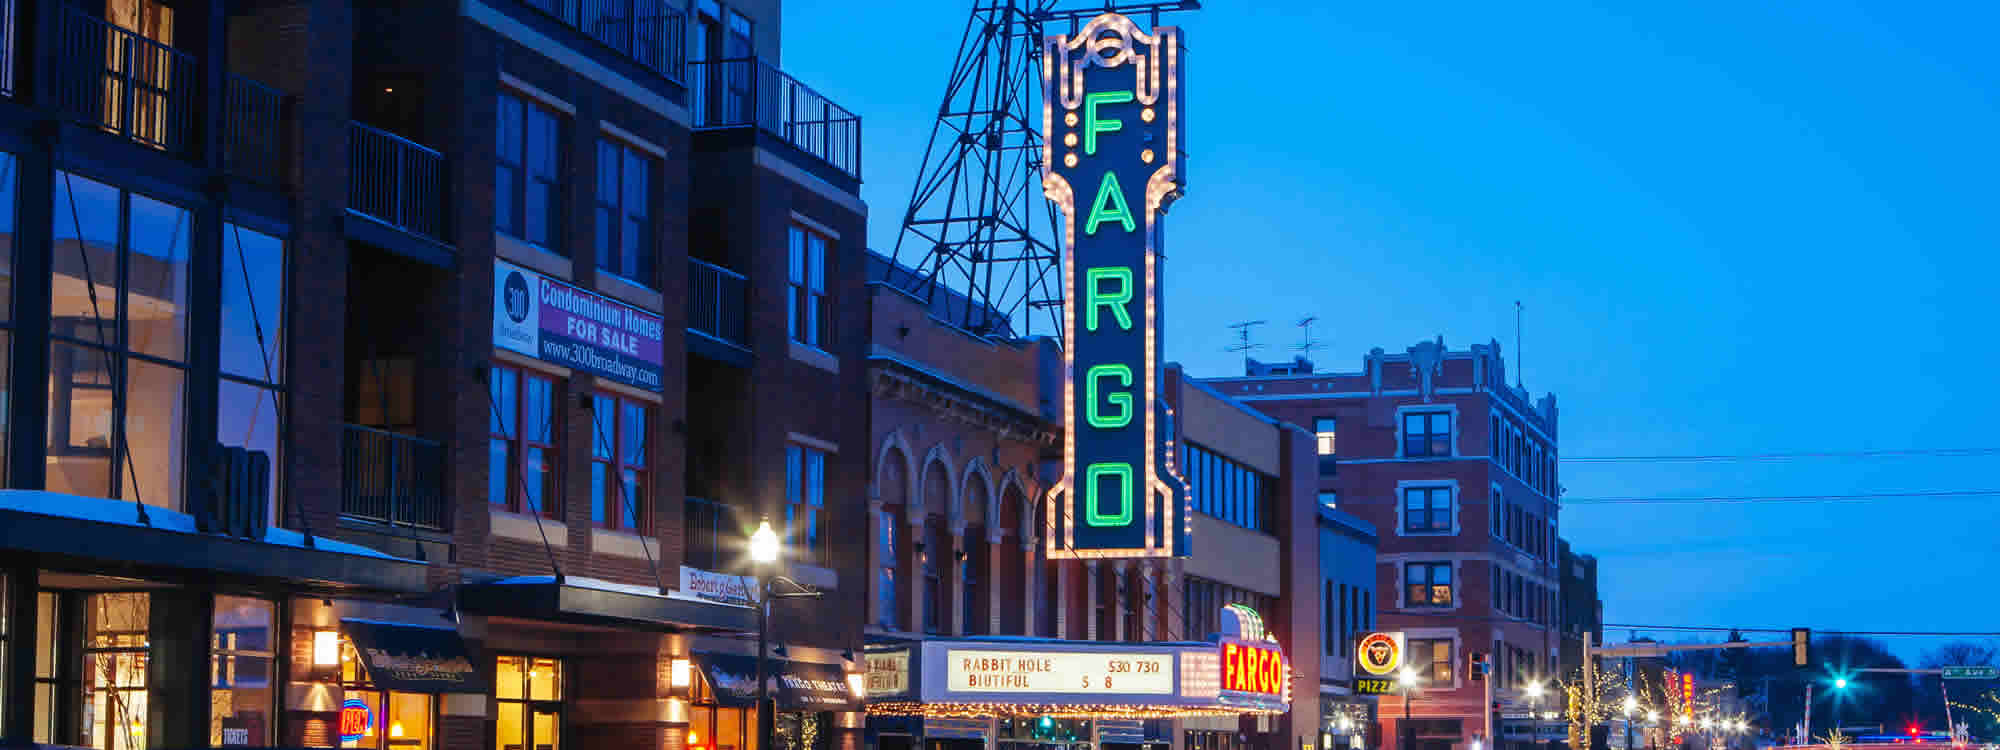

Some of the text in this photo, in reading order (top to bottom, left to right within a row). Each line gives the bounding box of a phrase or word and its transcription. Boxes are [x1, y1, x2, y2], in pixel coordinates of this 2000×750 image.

[541, 279, 663, 341] Condominium Homes
[1084, 90, 1136, 528] FARGO
[567, 316, 597, 342] FOR
[601, 328, 639, 355] SALE
[543, 340, 658, 385] www.300broadway.com
[963, 658, 1011, 673] RABBIT
[1018, 659, 1052, 673] HOLE
[1137, 661, 1160, 673] 730
[968, 674, 1030, 688] BIUTIFUL
[1104, 676, 1113, 689] 8
[1226, 644, 1282, 694] FARGO
